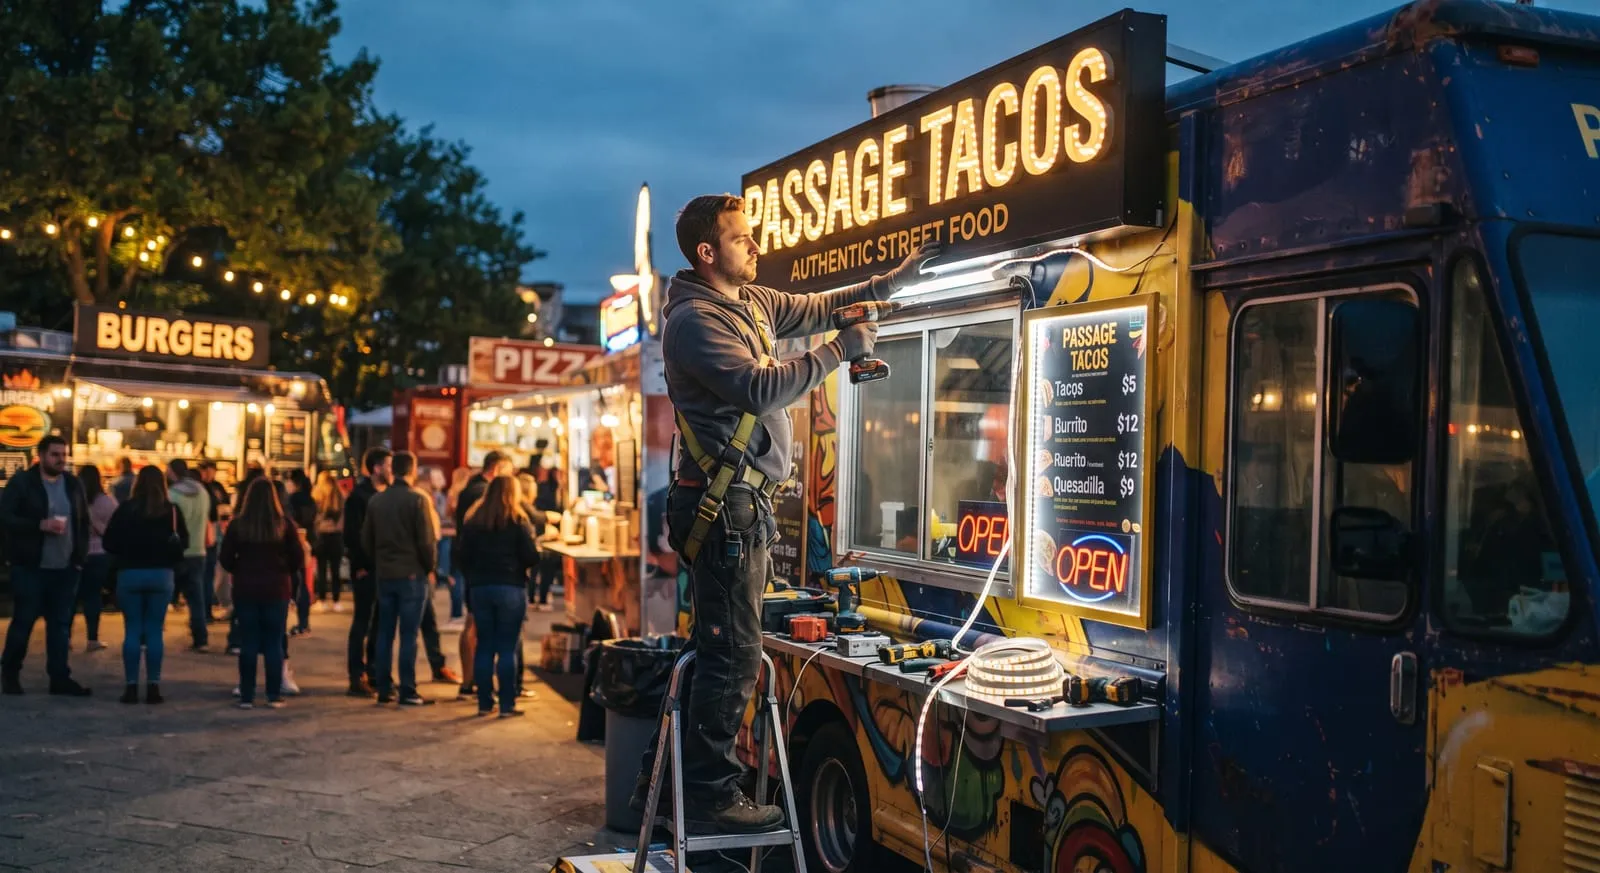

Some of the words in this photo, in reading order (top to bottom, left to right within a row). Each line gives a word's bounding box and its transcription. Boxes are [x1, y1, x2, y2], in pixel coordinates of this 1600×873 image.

[744, 125, 910, 256] PASSAGE
[920, 47, 1108, 206] TACOS
[790, 239, 874, 282] AUTHENTIC
[877, 219, 944, 263] STREET
[949, 203, 1009, 244] FOOD
[97, 311, 255, 362] BURGERS
[1062, 321, 1118, 349] PASSAGE
[494, 346, 607, 383] PIZZ
[1070, 347, 1109, 371] TACOS
[1055, 380, 1084, 398] Tacos
[1122, 373, 1137, 396] $5
[1055, 416, 1088, 434] Burrito
[1117, 412, 1139, 435] $12
[1054, 452, 1087, 468] Ruerito
[1118, 450, 1138, 470] $12
[1053, 475, 1105, 496] Quesadilla
[1120, 475, 1135, 499] $9
[1056, 545, 1128, 593] OPEN
